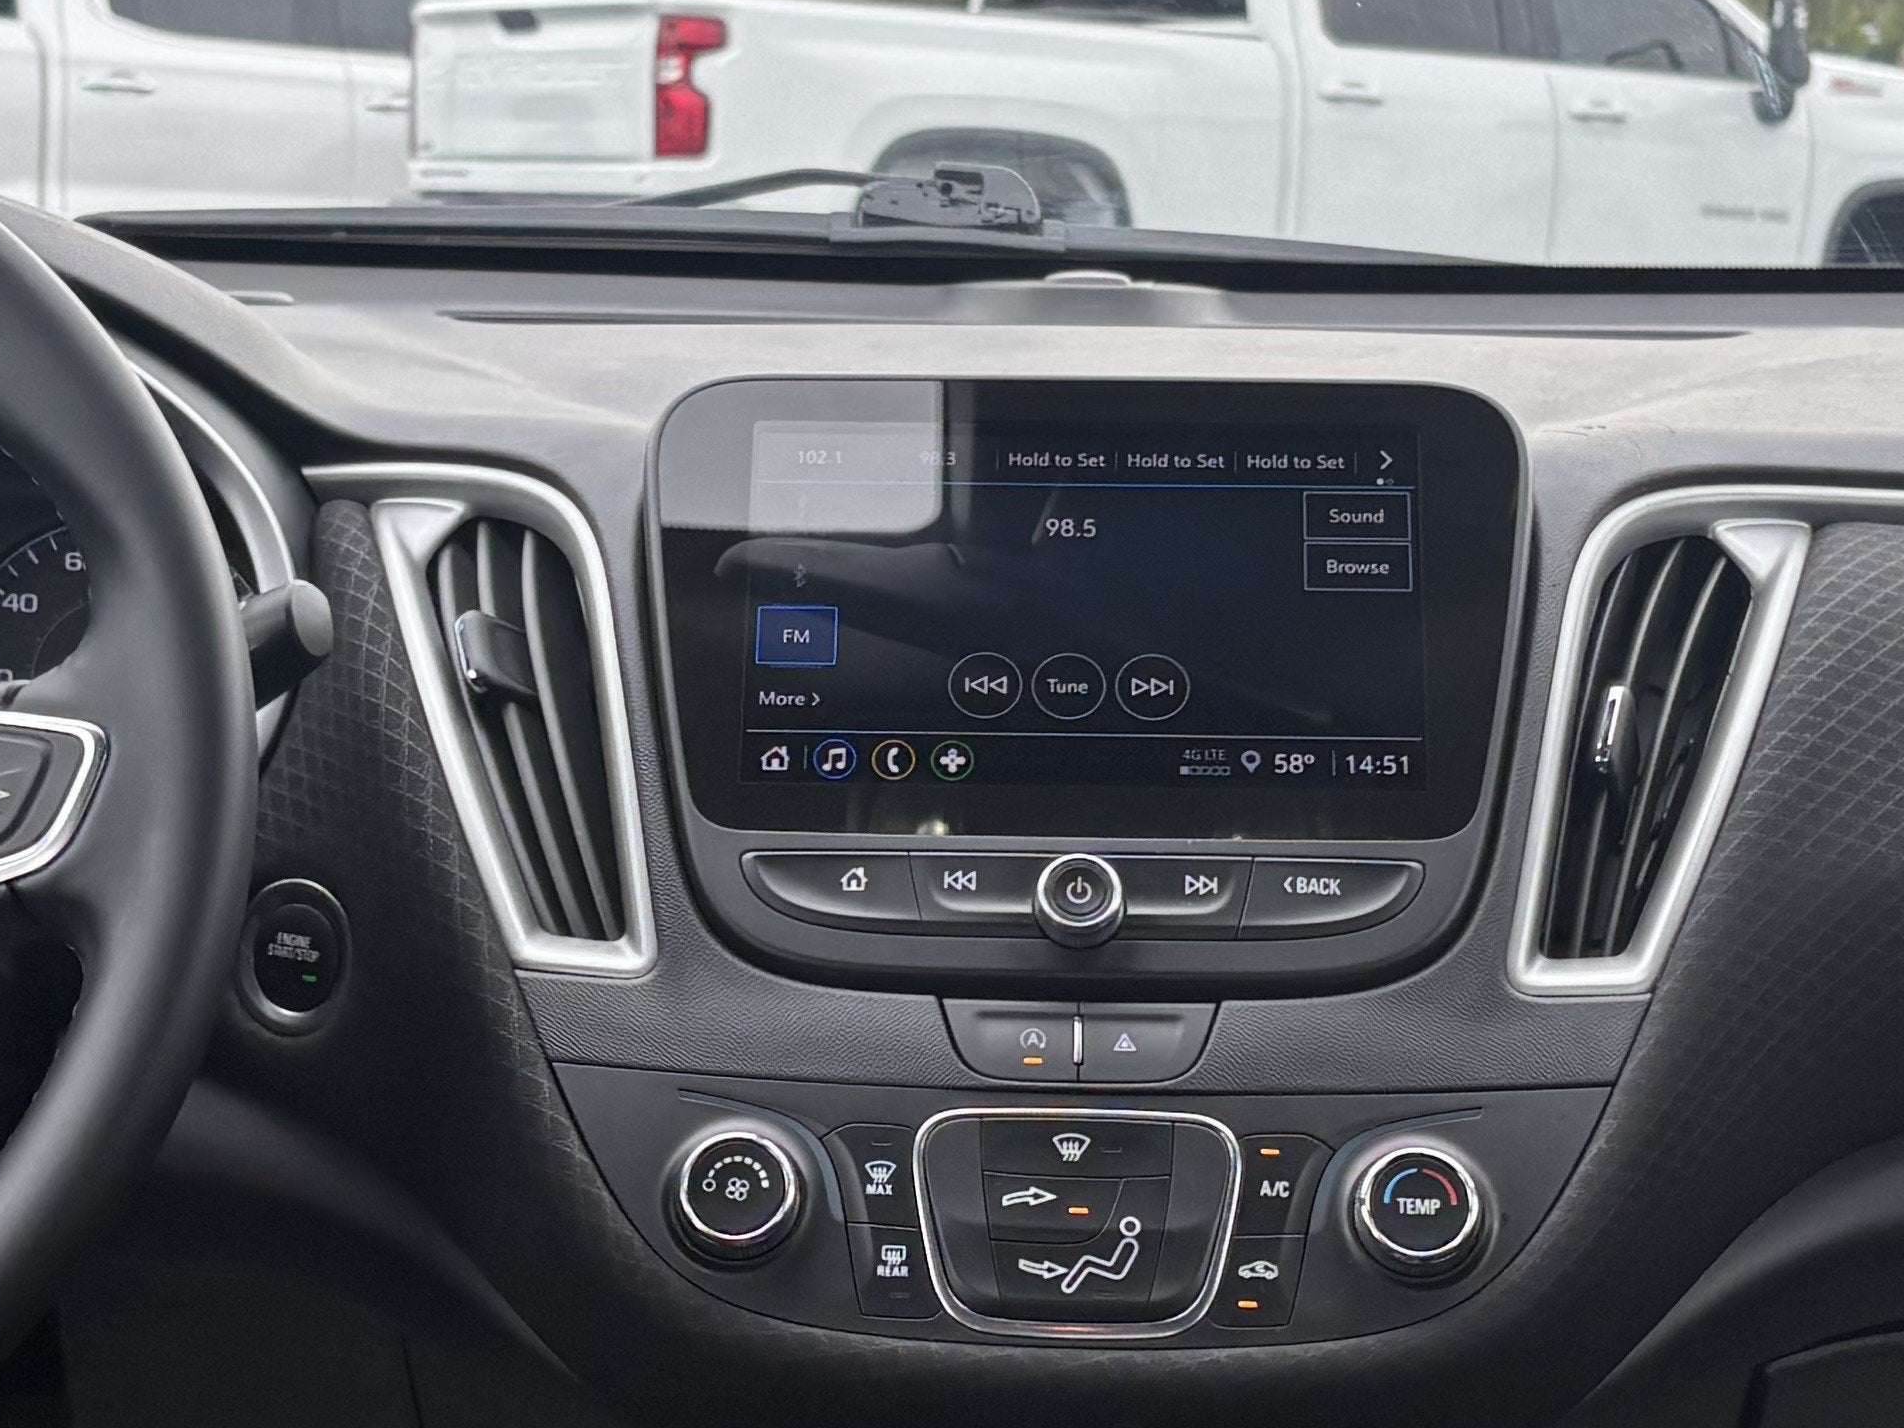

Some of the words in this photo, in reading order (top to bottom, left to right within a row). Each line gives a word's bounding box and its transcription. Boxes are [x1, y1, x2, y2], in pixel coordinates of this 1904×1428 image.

[797, 449, 843, 466] 102.1
[1008, 451, 1050, 469] Hold
[1053, 452, 1071, 469] to
[1076, 452, 1106, 469] Set
[1127, 452, 1168, 470] Hold
[1173, 453, 1190, 470] to
[1196, 453, 1225, 470] Set
[1246, 453, 1287, 471] Hold
[1293, 454, 1310, 471] to
[1316, 454, 1345, 471] Set
[1329, 507, 1386, 525] Sound
[1045, 517, 1097, 539] 98.5
[64, 552, 86, 571] 6
[1325, 558, 1391, 577] Browse
[2, 593, 38, 613] 40
[782, 628, 810, 644] FM
[1047, 679, 1089, 695] Tune
[759, 691, 806, 706] More
[1182, 749, 1201, 761] 4G
[1204, 749, 1227, 761] LTE
[1346, 754, 1410, 775] 14:51
[1295, 875, 1342, 896] BACK
[865, 1178, 894, 1197] MAX
[1259, 1177, 1290, 1202] A/C
[1397, 1196, 1442, 1218] TEMP
[876, 1263, 909, 1279] REAR
